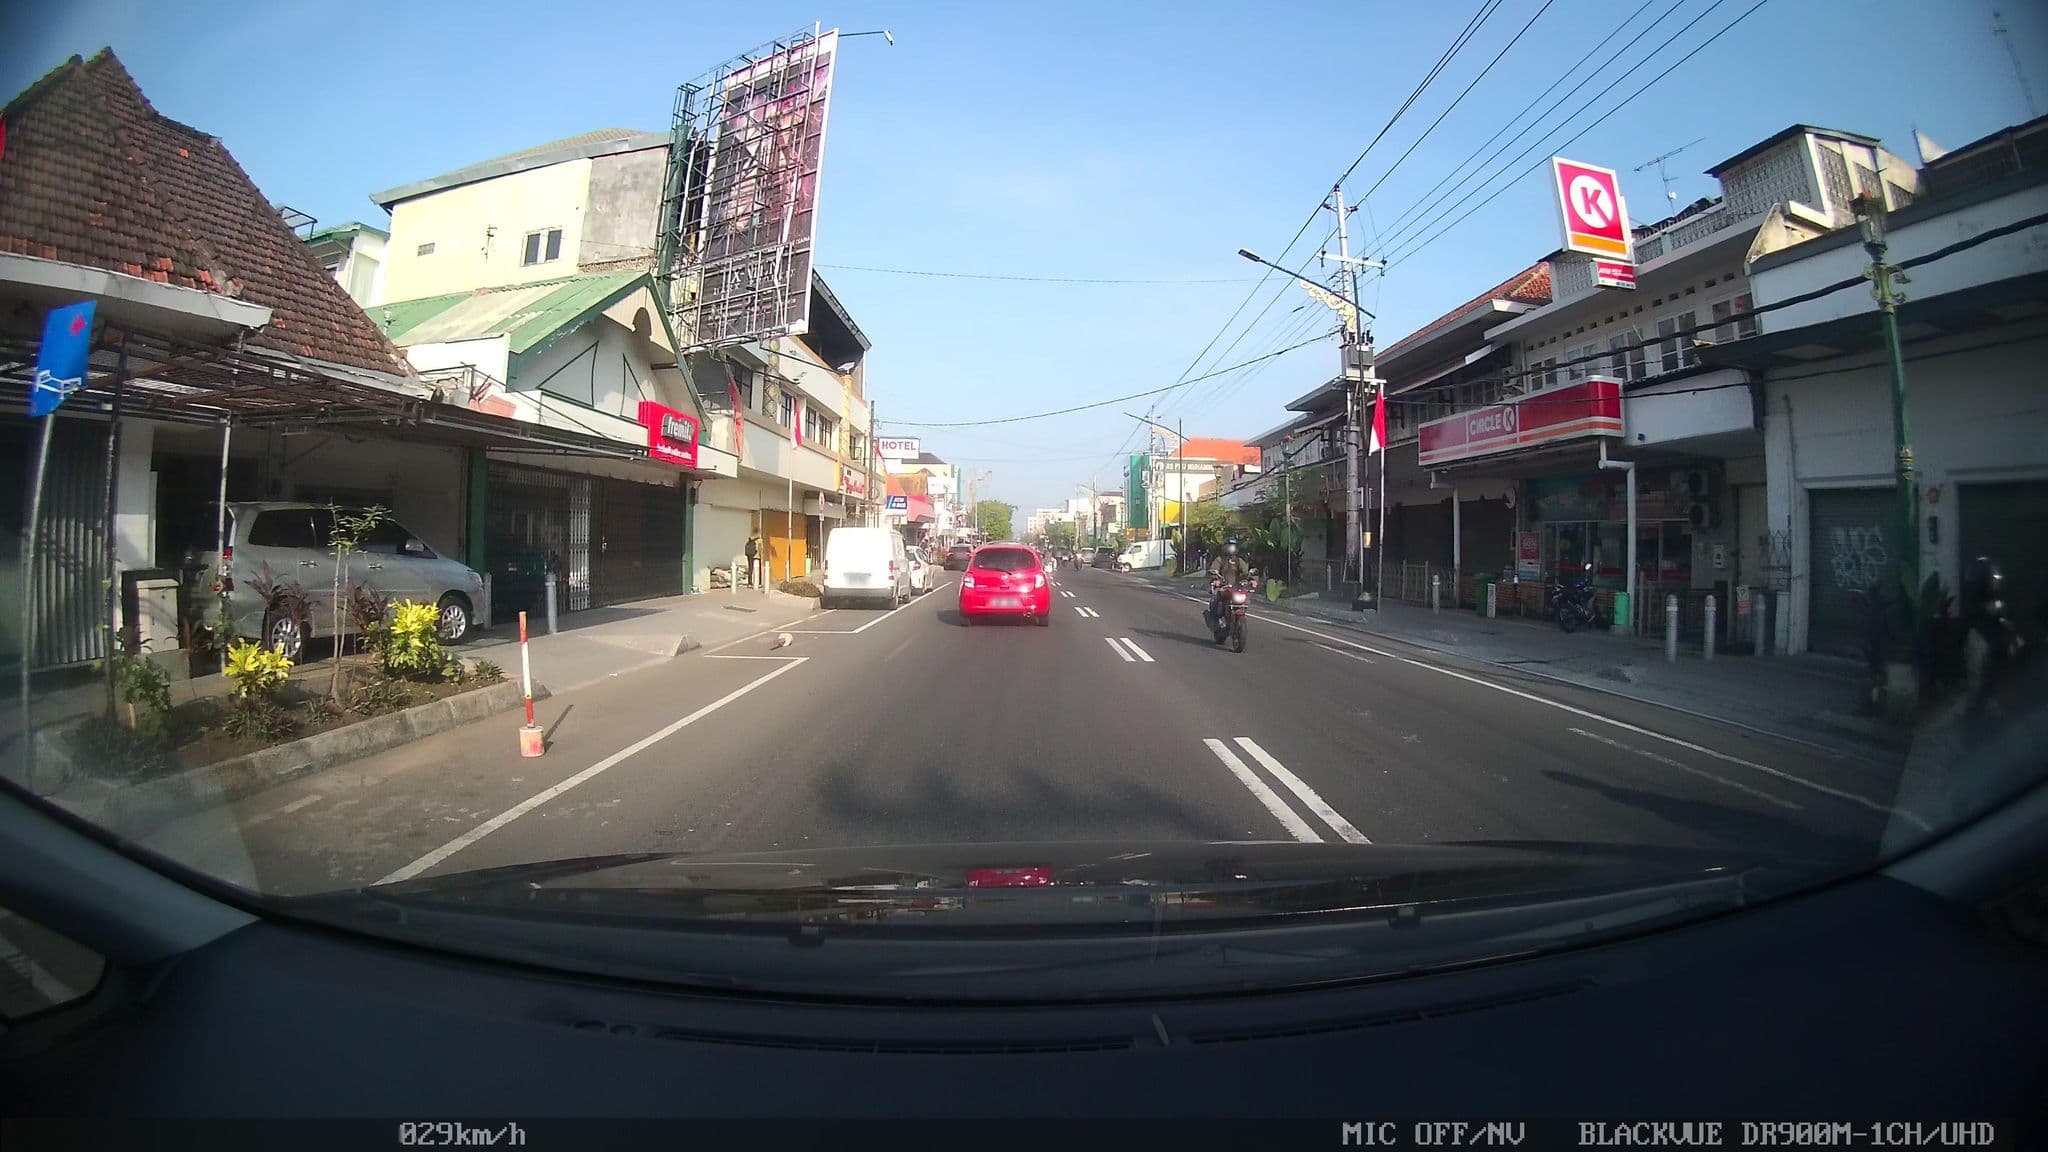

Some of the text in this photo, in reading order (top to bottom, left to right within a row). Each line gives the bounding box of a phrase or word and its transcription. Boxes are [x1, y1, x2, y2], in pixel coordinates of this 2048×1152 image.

[1580, 186, 1612, 227] K
[1469, 408, 1515, 436] CIRCLE K
[881, 441, 917, 451] HOTEL
